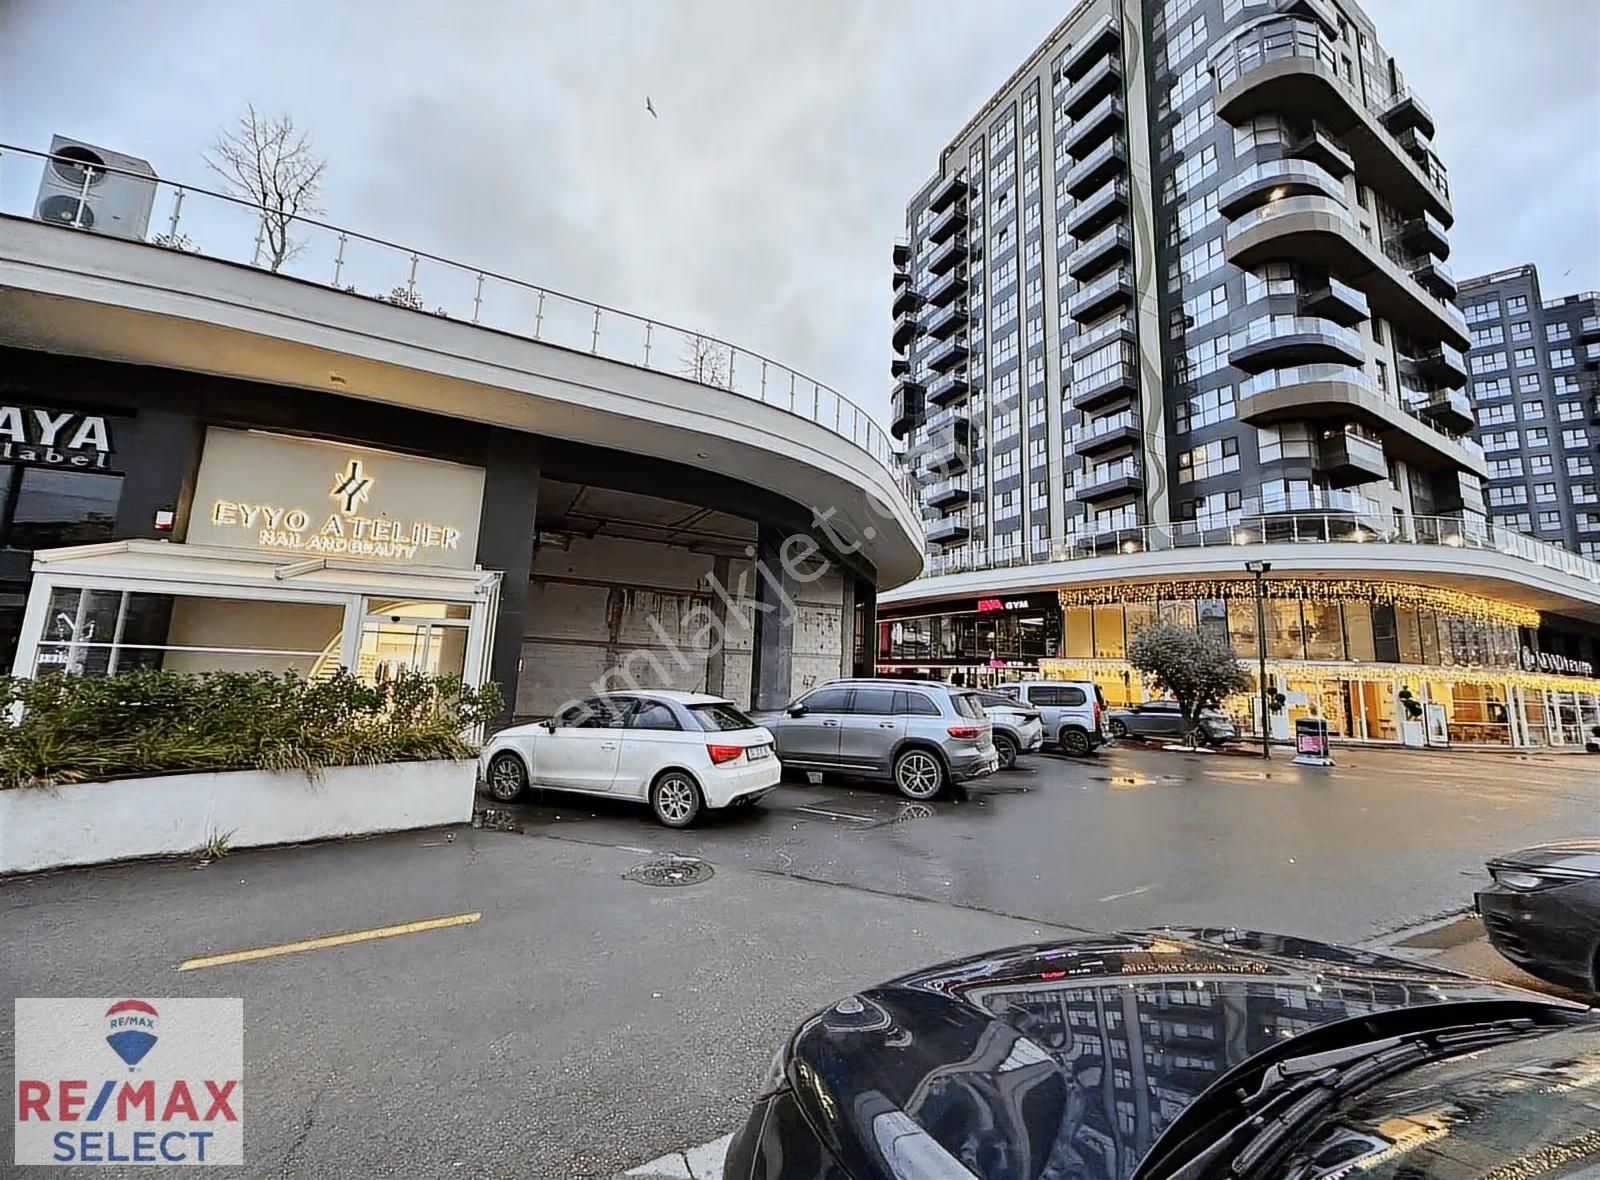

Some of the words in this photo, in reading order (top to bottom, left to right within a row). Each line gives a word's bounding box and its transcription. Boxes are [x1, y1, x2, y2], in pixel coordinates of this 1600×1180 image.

[0, 406, 109, 451] AYA
[4, 442, 106, 468] label
[212, 500, 309, 532] EYYO
[320, 513, 463, 550] ATELIER
[259, 529, 304, 549] NAIL
[307, 534, 347, 552] AND
[350, 539, 417, 559] BEAUTY
[1005, 600, 1029, 609] GYM
